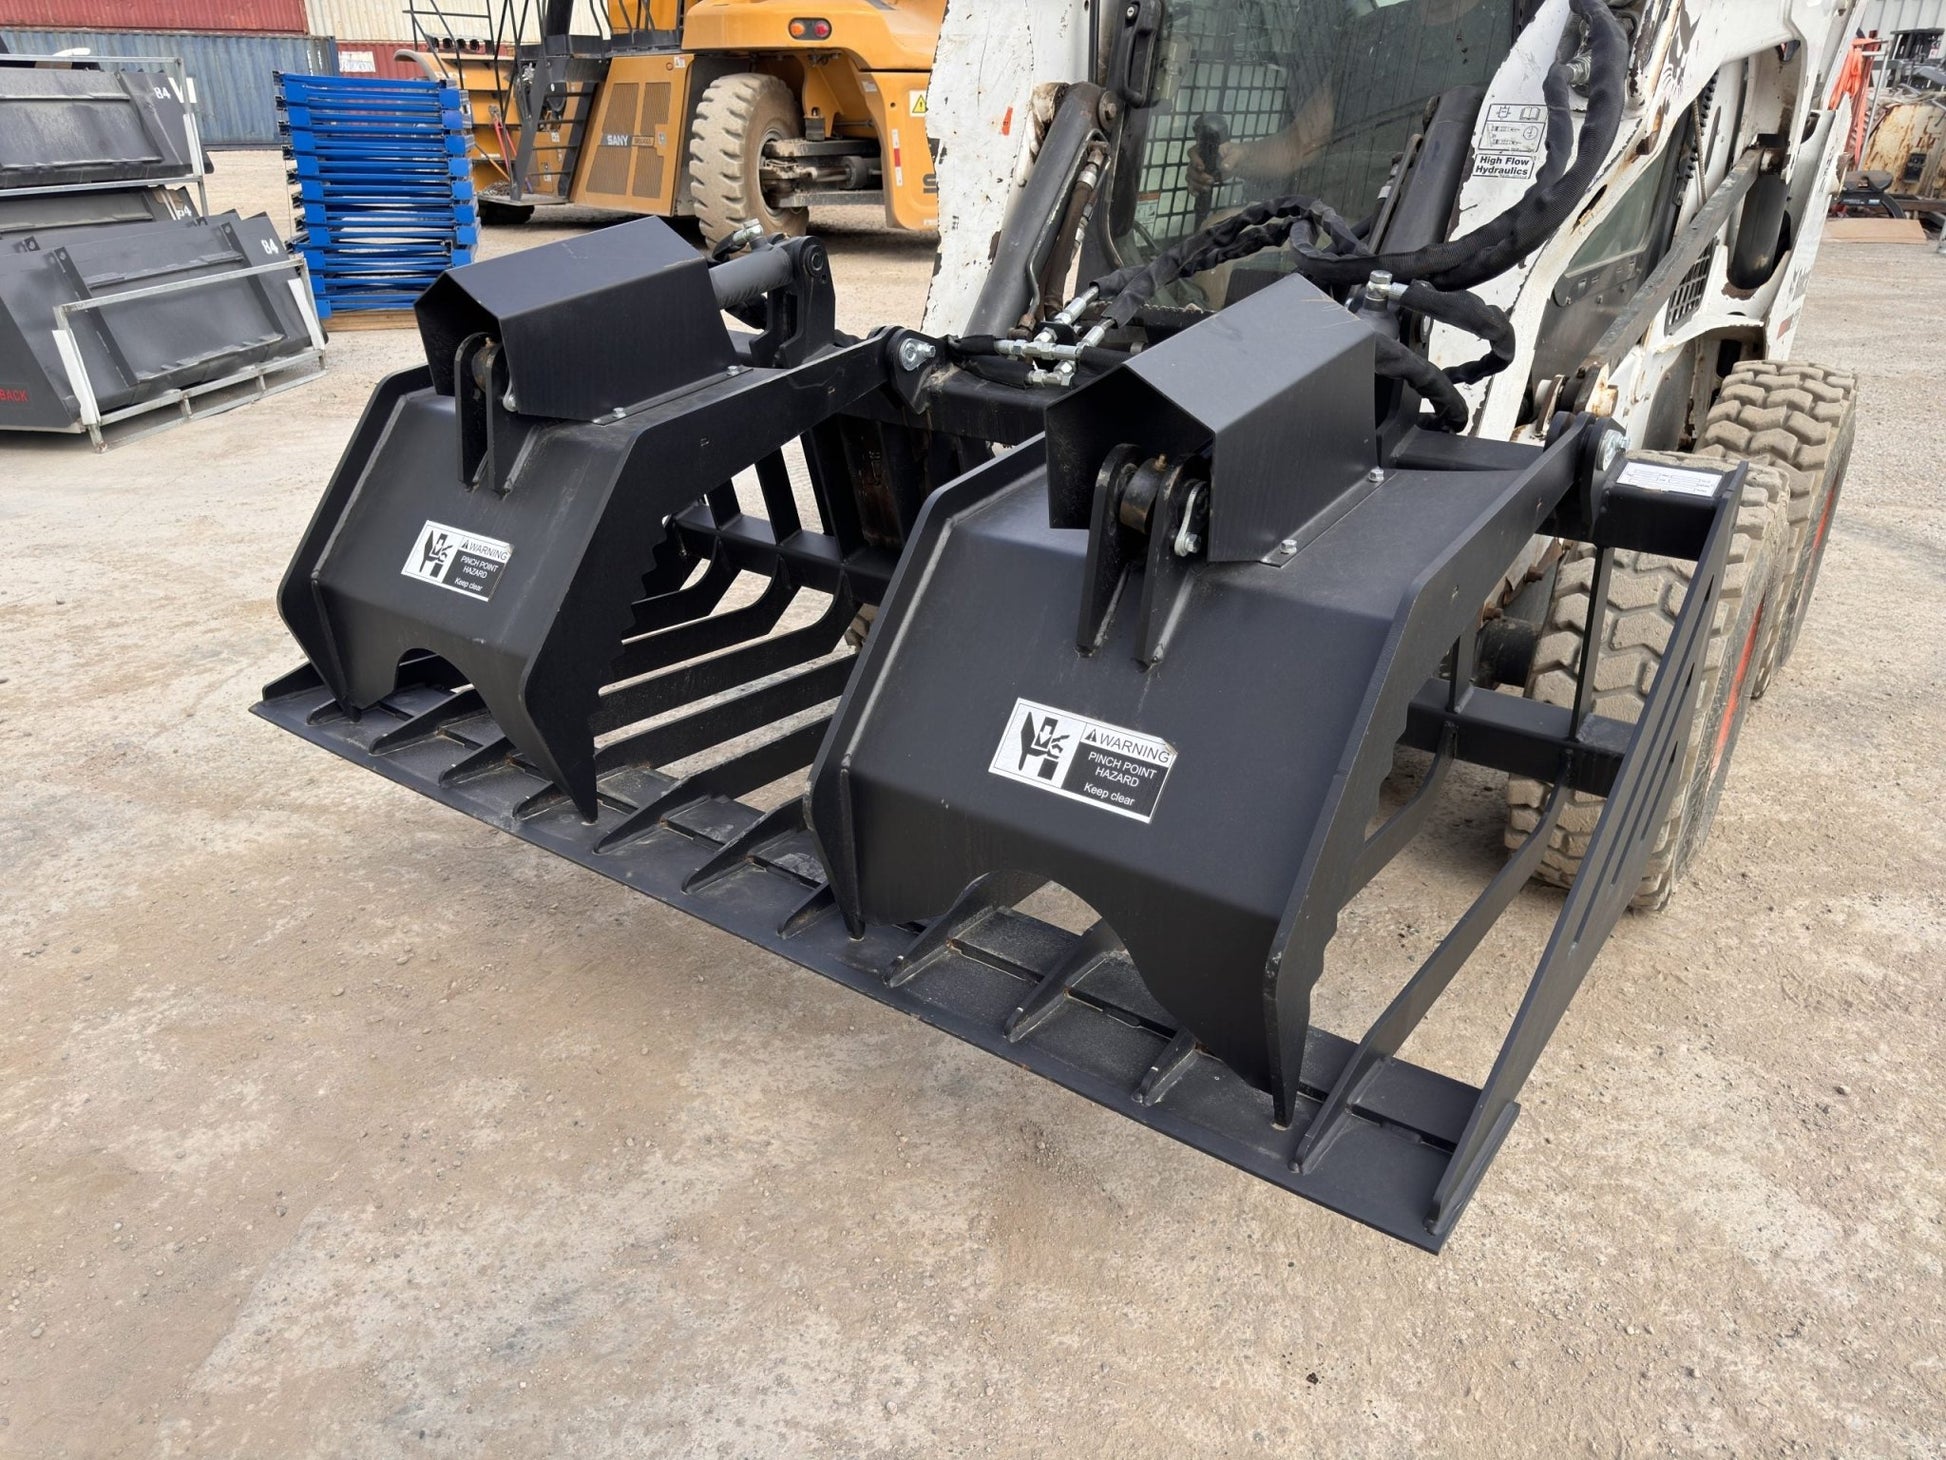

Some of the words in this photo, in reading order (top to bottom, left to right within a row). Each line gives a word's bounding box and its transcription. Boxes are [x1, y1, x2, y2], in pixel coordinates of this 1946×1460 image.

[154, 86, 171, 100] 84
[606, 133, 629, 146] SANY
[1479, 155, 1503, 166] High
[1504, 156, 1530, 167] Flow
[1475, 165, 1528, 176] Hydraulics
[261, 238, 279, 255] 84
[469, 541, 509, 561] WARNING
[460, 555, 479, 568] PINCH
[479, 560, 499, 573] POINT
[463, 566, 488, 579] HAZARD
[454, 577, 470, 589] Keep
[469, 581, 483, 592] clear
[1099, 732, 1171, 764] WARNING
[1088, 751, 1122, 769] PINCH
[1122, 760, 1158, 780] POINT
[1095, 766, 1140, 787] HAZARD
[1083, 782, 1109, 799] Keep
[1110, 791, 1136, 806] clear
